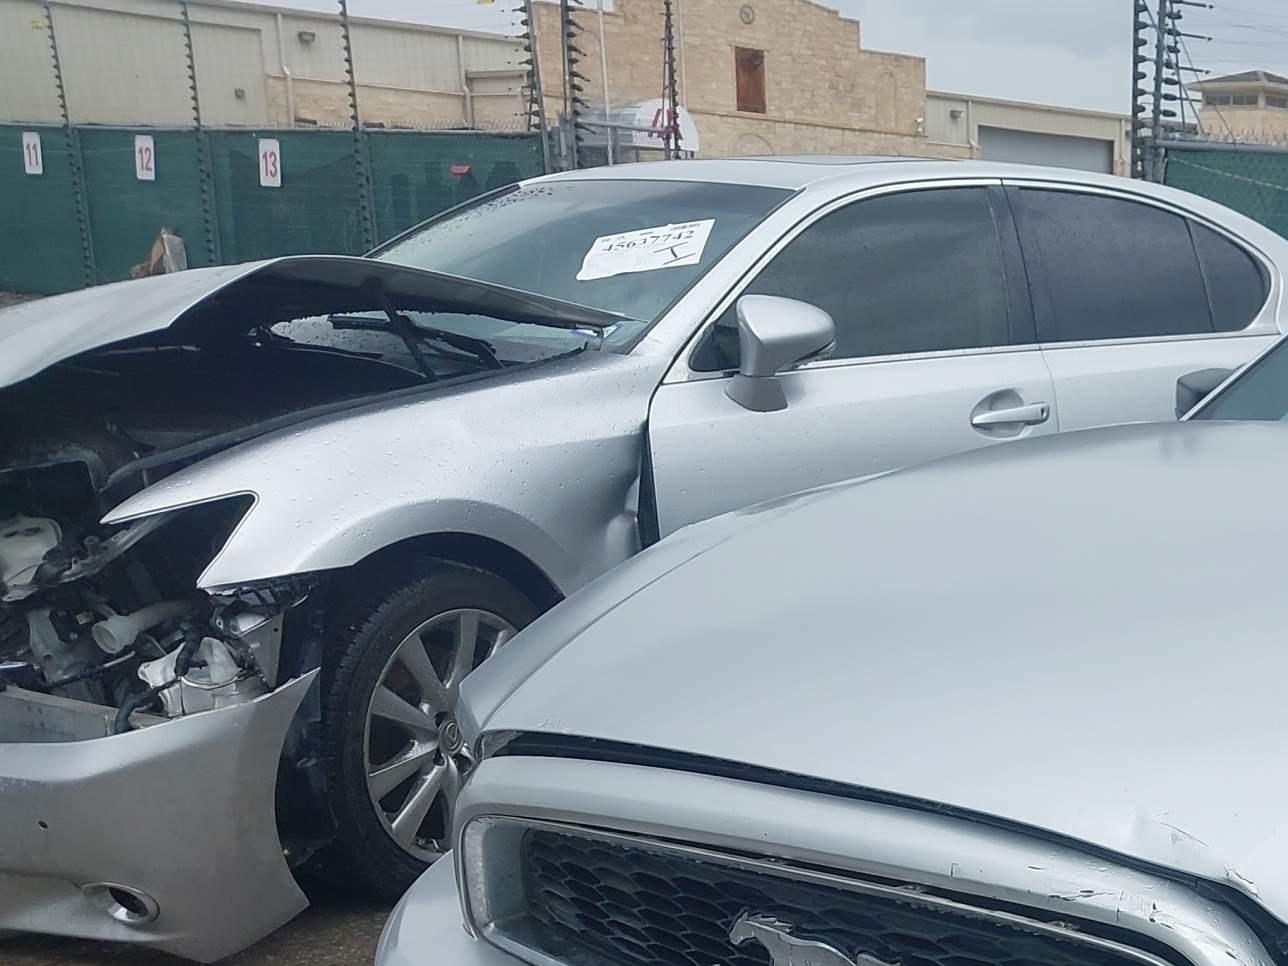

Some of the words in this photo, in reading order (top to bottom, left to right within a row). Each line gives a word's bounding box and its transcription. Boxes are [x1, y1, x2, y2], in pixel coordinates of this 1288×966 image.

[26, 142, 39, 167] 11
[138, 146, 153, 172] 12
[262, 150, 278, 178] 13
